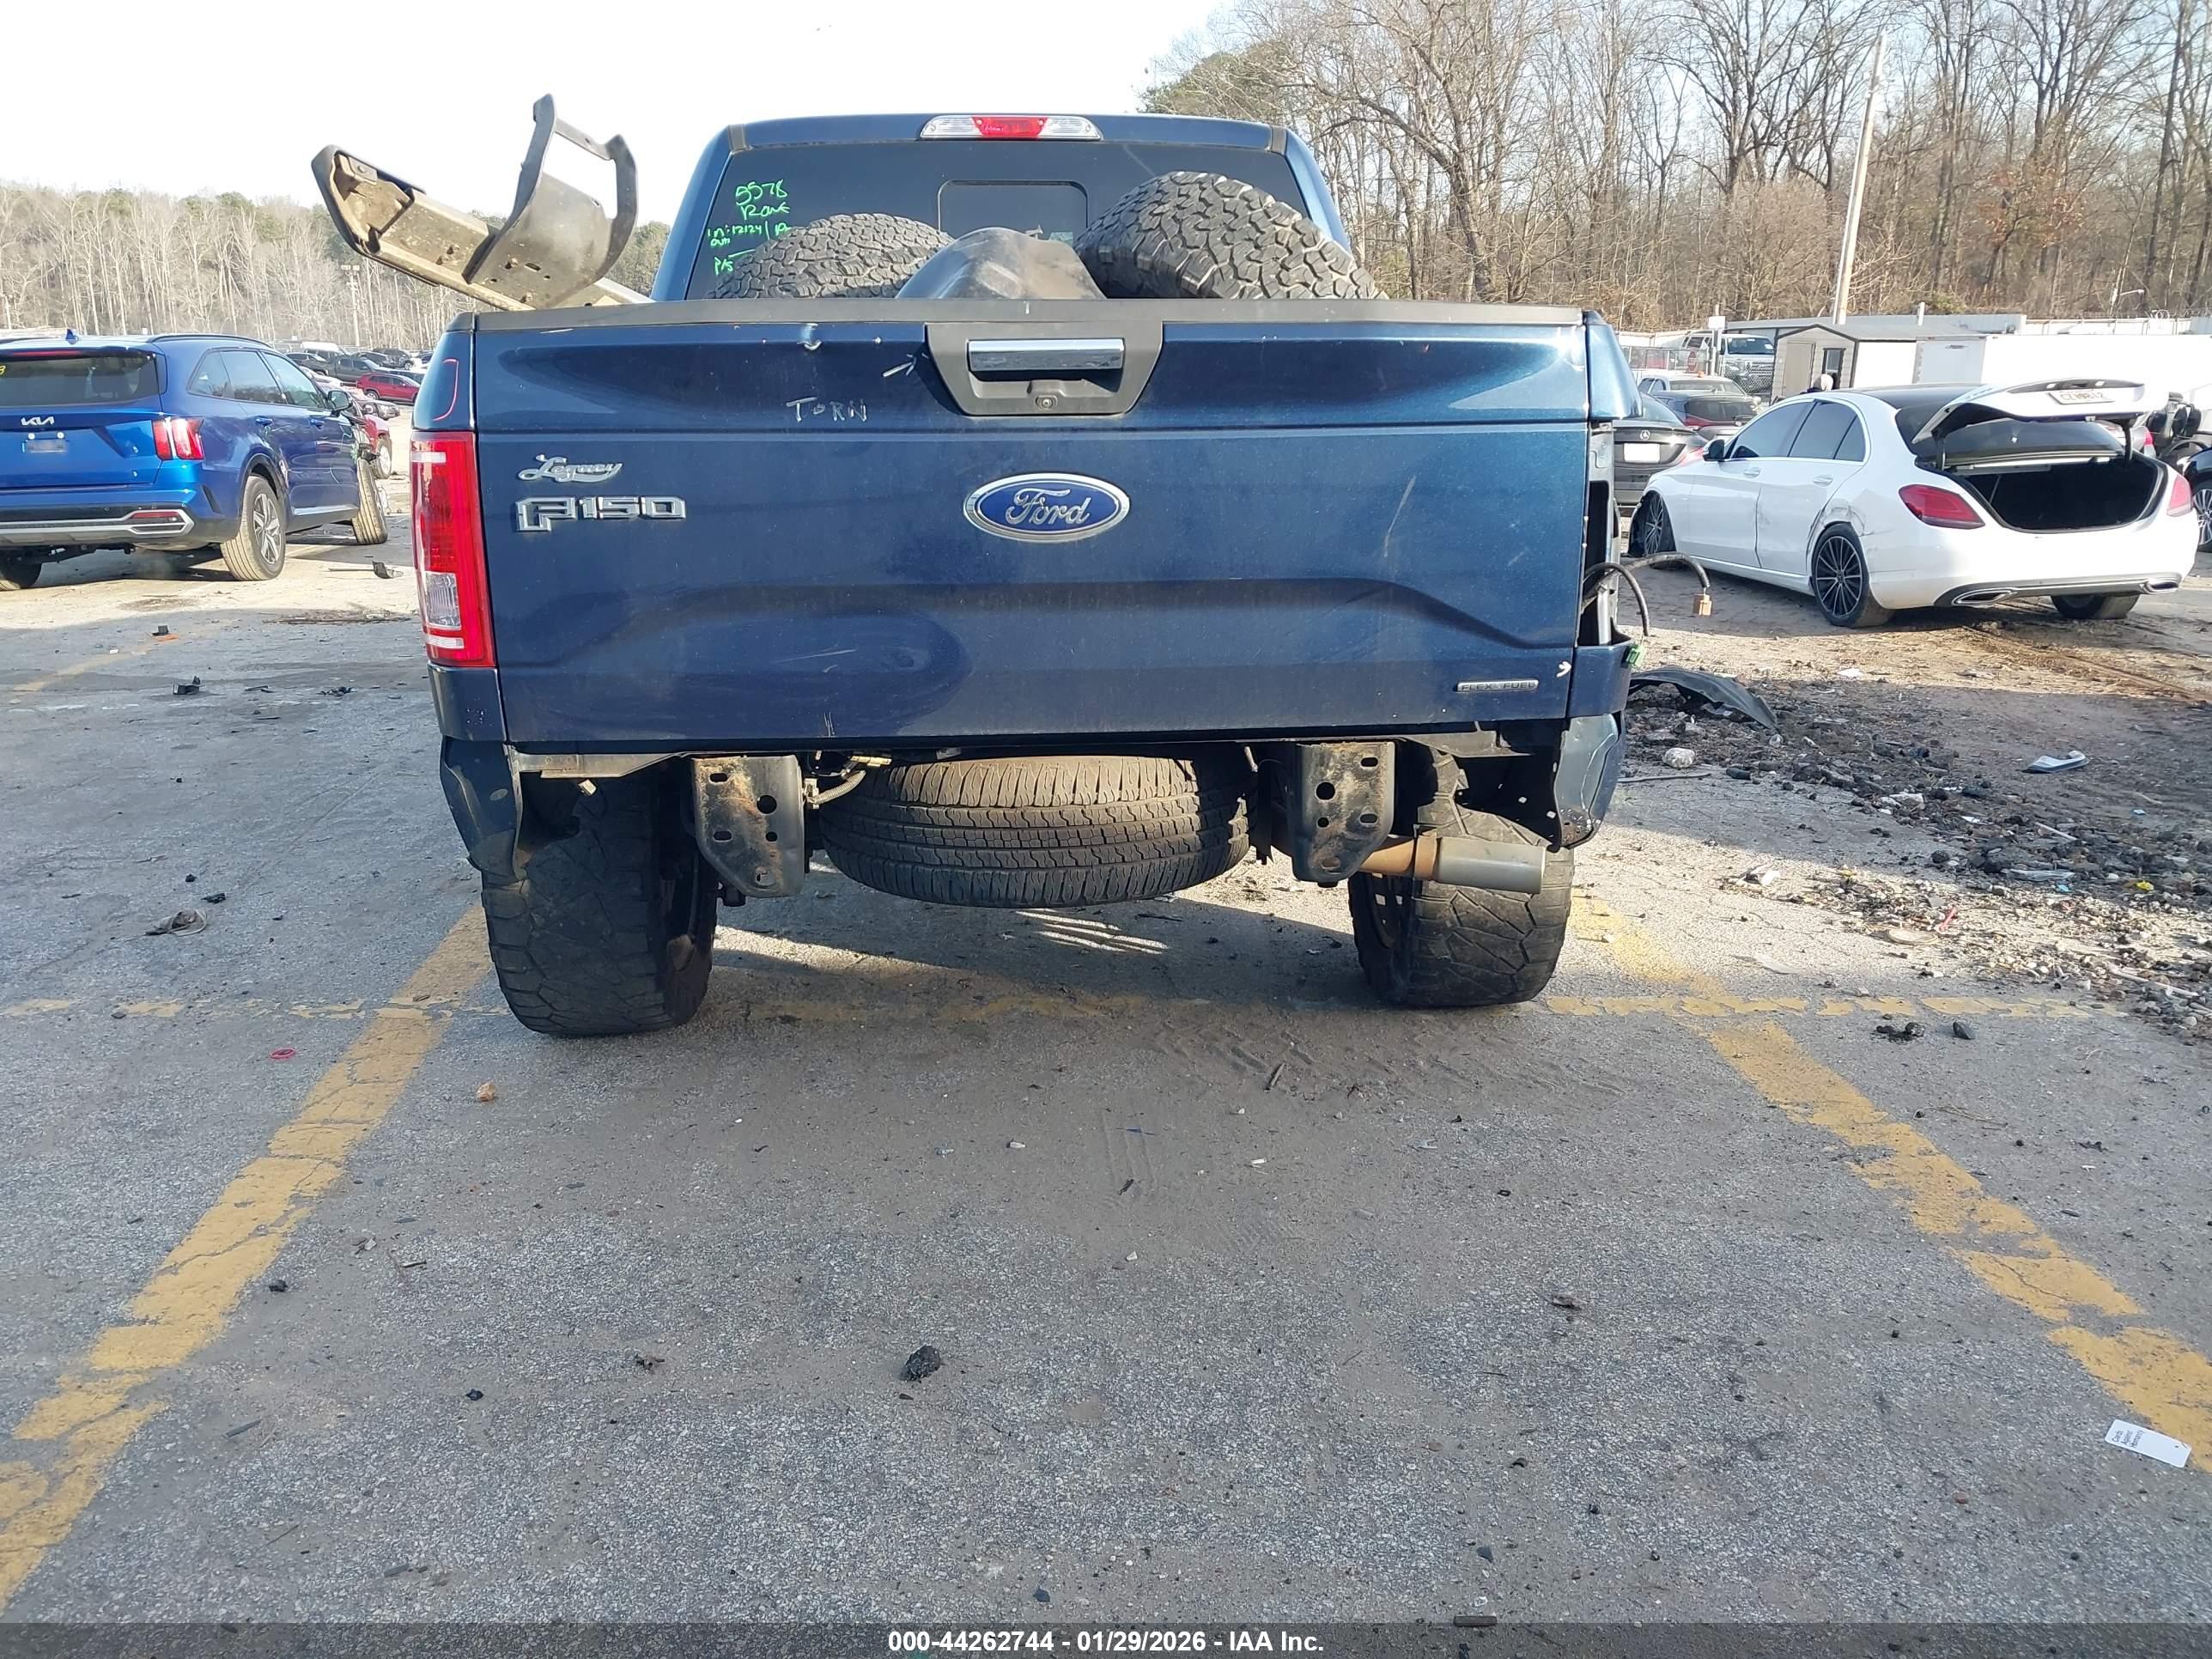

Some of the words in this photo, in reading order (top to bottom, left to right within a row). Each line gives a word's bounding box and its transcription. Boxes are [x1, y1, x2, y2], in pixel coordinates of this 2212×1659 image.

[735, 179, 788, 206] 5578
[21, 416, 55, 426] KIA
[516, 453, 624, 483] Legacy
[1005, 486, 1092, 527] Ford
